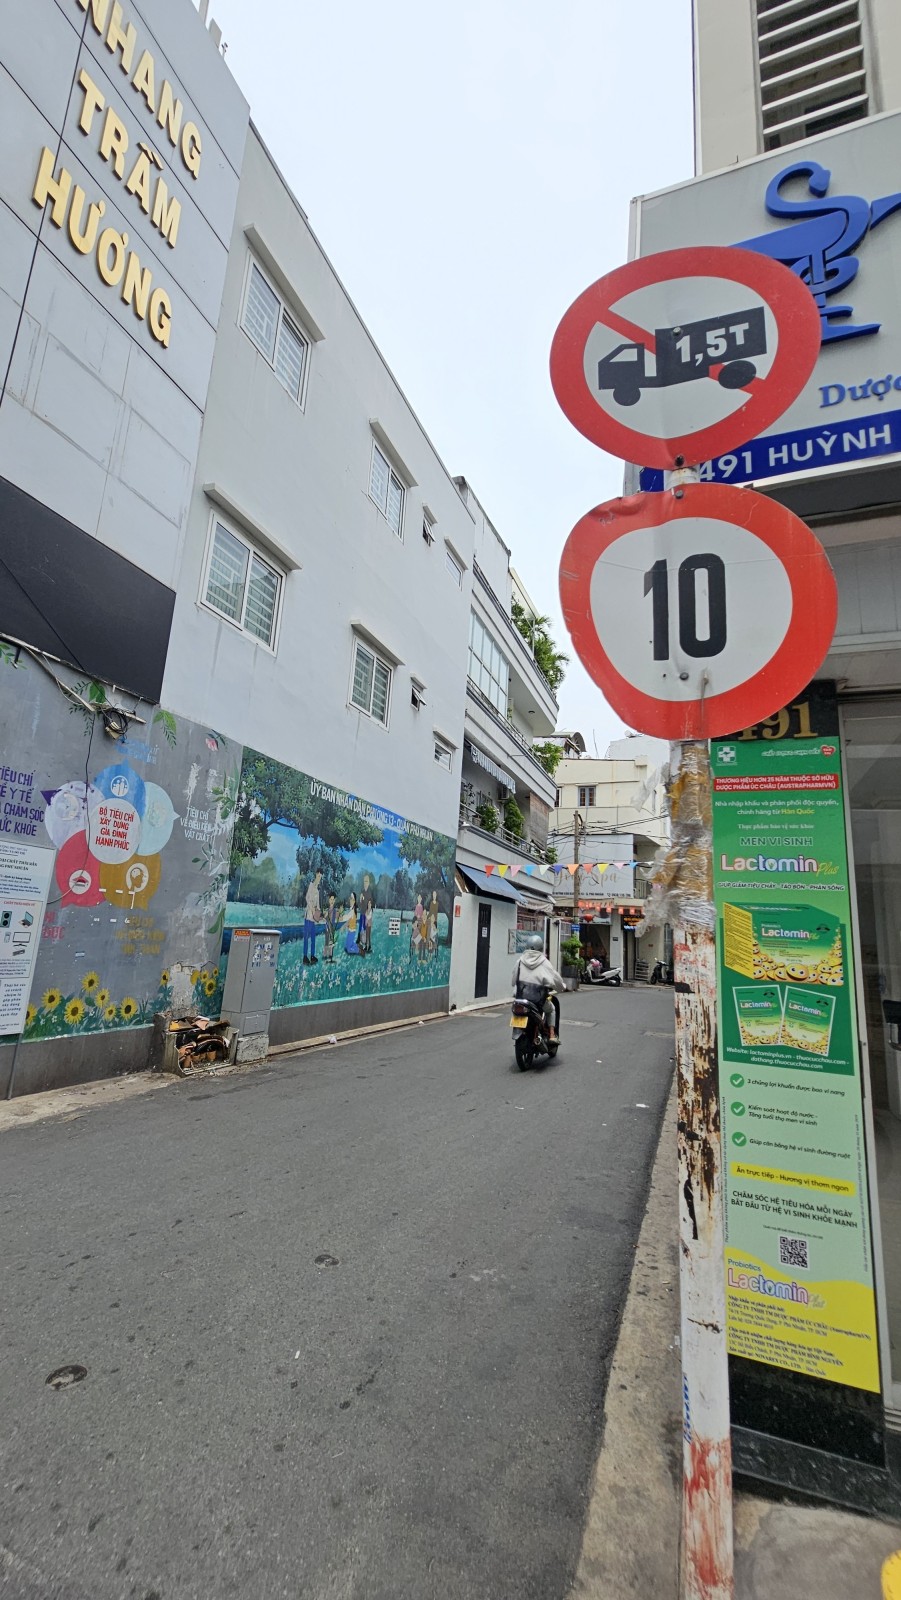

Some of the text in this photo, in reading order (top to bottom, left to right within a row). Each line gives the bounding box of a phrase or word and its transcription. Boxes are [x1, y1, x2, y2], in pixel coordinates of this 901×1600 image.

[31, 146, 173, 350] HƯƠNG
[676, 322, 750, 366] 1,5T
[699, 424, 892, 481] 491 HUỲNH
[643, 553, 727, 661] 10
[738, 702, 818, 741] 91
[18, 770, 36, 787] CHÍ
[10, 787, 34, 803] Y TẾ
[311, 778, 322, 797] ỦY
[321, 786, 336, 803] BAN
[336, 791, 354, 811] NHÂN
[29, 807, 44, 822] SÓC
[109, 807, 123, 820] TIÊU
[123, 811, 135, 822] CHÍ
[113, 839, 129, 851] PHÚC
[740, 836, 814, 846] MEN VI SINH
[721, 853, 839, 876] Lactomin Plus
[761, 927, 809, 939] Lactomin
[731, 1198, 743, 1207] BẮT
[745, 1201, 759, 1210] ĐẦU
[761, 1204, 771, 1212] TỪ
[773, 1206, 782, 1215] HỆ
[793, 1210, 810, 1220] SINH
[812, 1213, 832, 1224] KHỎE
[834, 1218, 858, 1229] MẠNH
[733, 1189, 852, 1218] CHĂM SÓC HỆ TIÊU HÓA MỖI NGÀY
[727, 1258, 762, 1272] Probiotics
[727, 1267, 809, 1305] Lactomin
